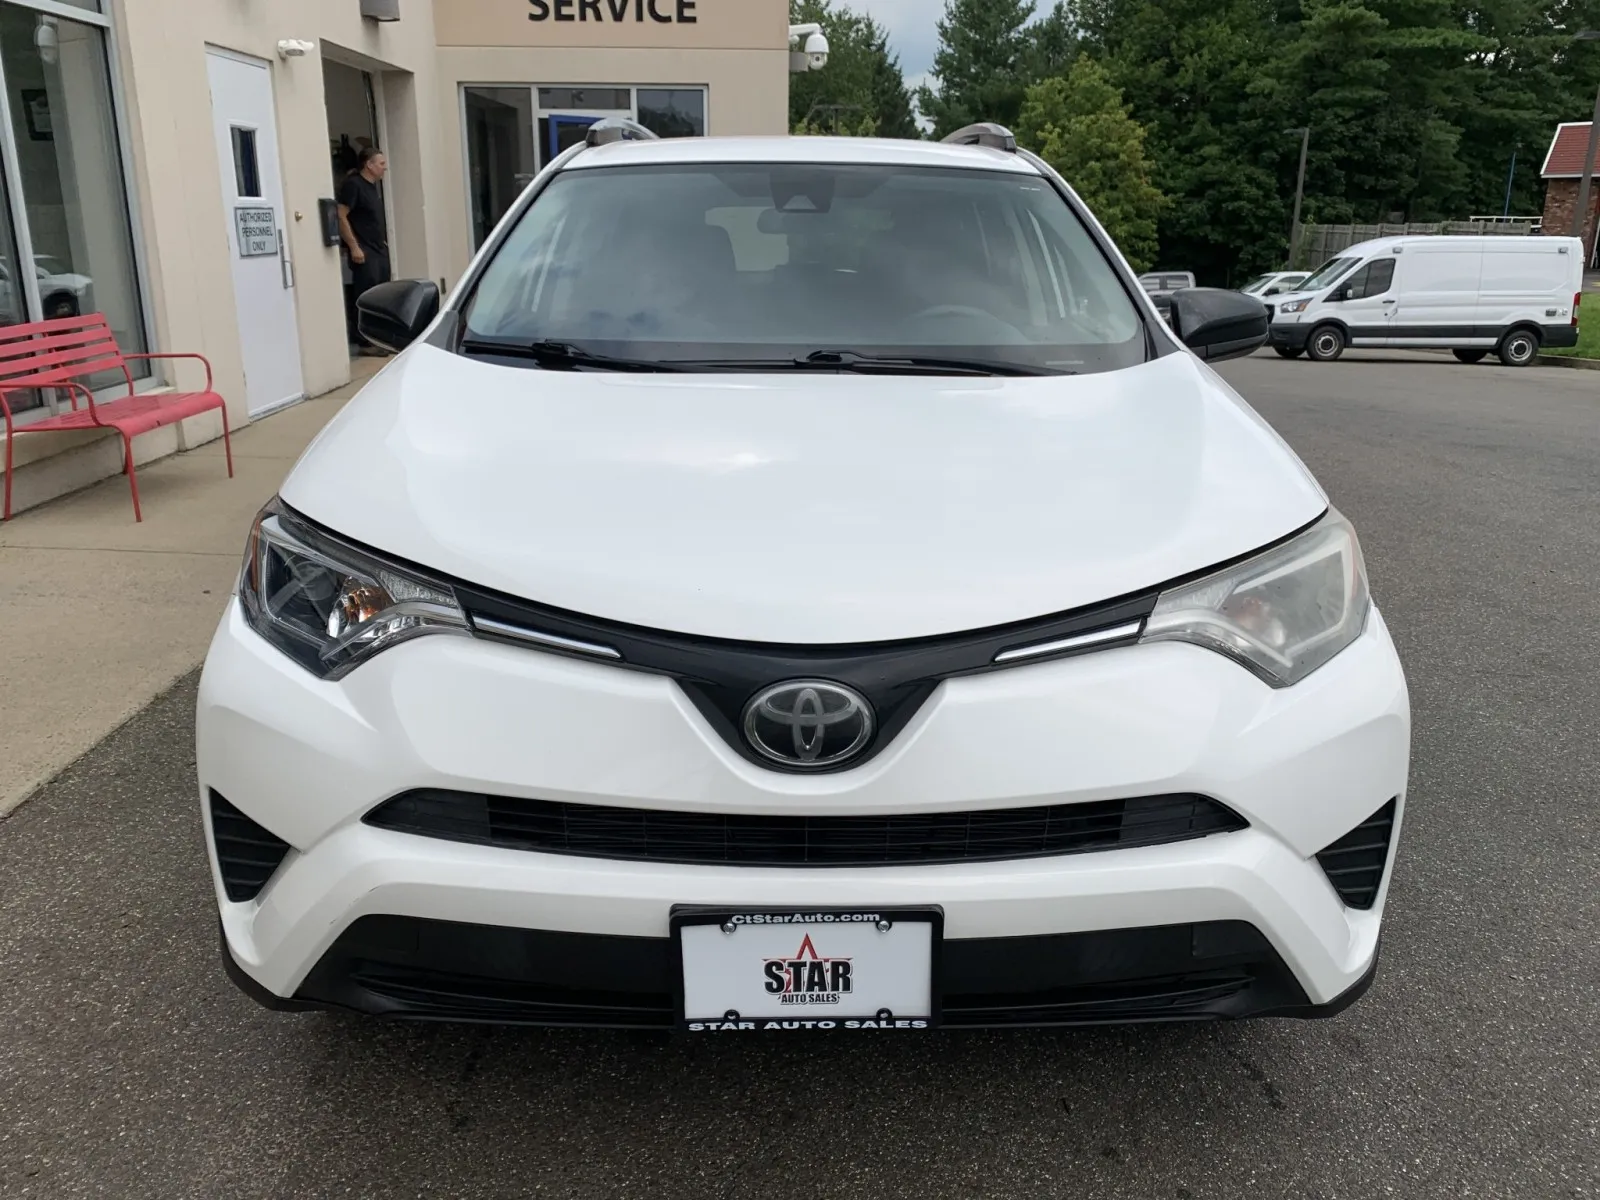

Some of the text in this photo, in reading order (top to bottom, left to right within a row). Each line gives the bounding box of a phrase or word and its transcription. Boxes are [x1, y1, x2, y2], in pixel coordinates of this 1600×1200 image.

[528, 0, 697, 23] SERVICE
[239, 212, 272, 222] AUTHORIZED
[242, 226, 273, 237] PERSONNEL
[252, 241, 266, 251] ONLY
[731, 913, 880, 924] CtStarAuto.com
[763, 960, 853, 994] STAR
[780, 993, 838, 1004] AUTO SALES
[688, 1020, 928, 1031] STAR AUTO SALES
